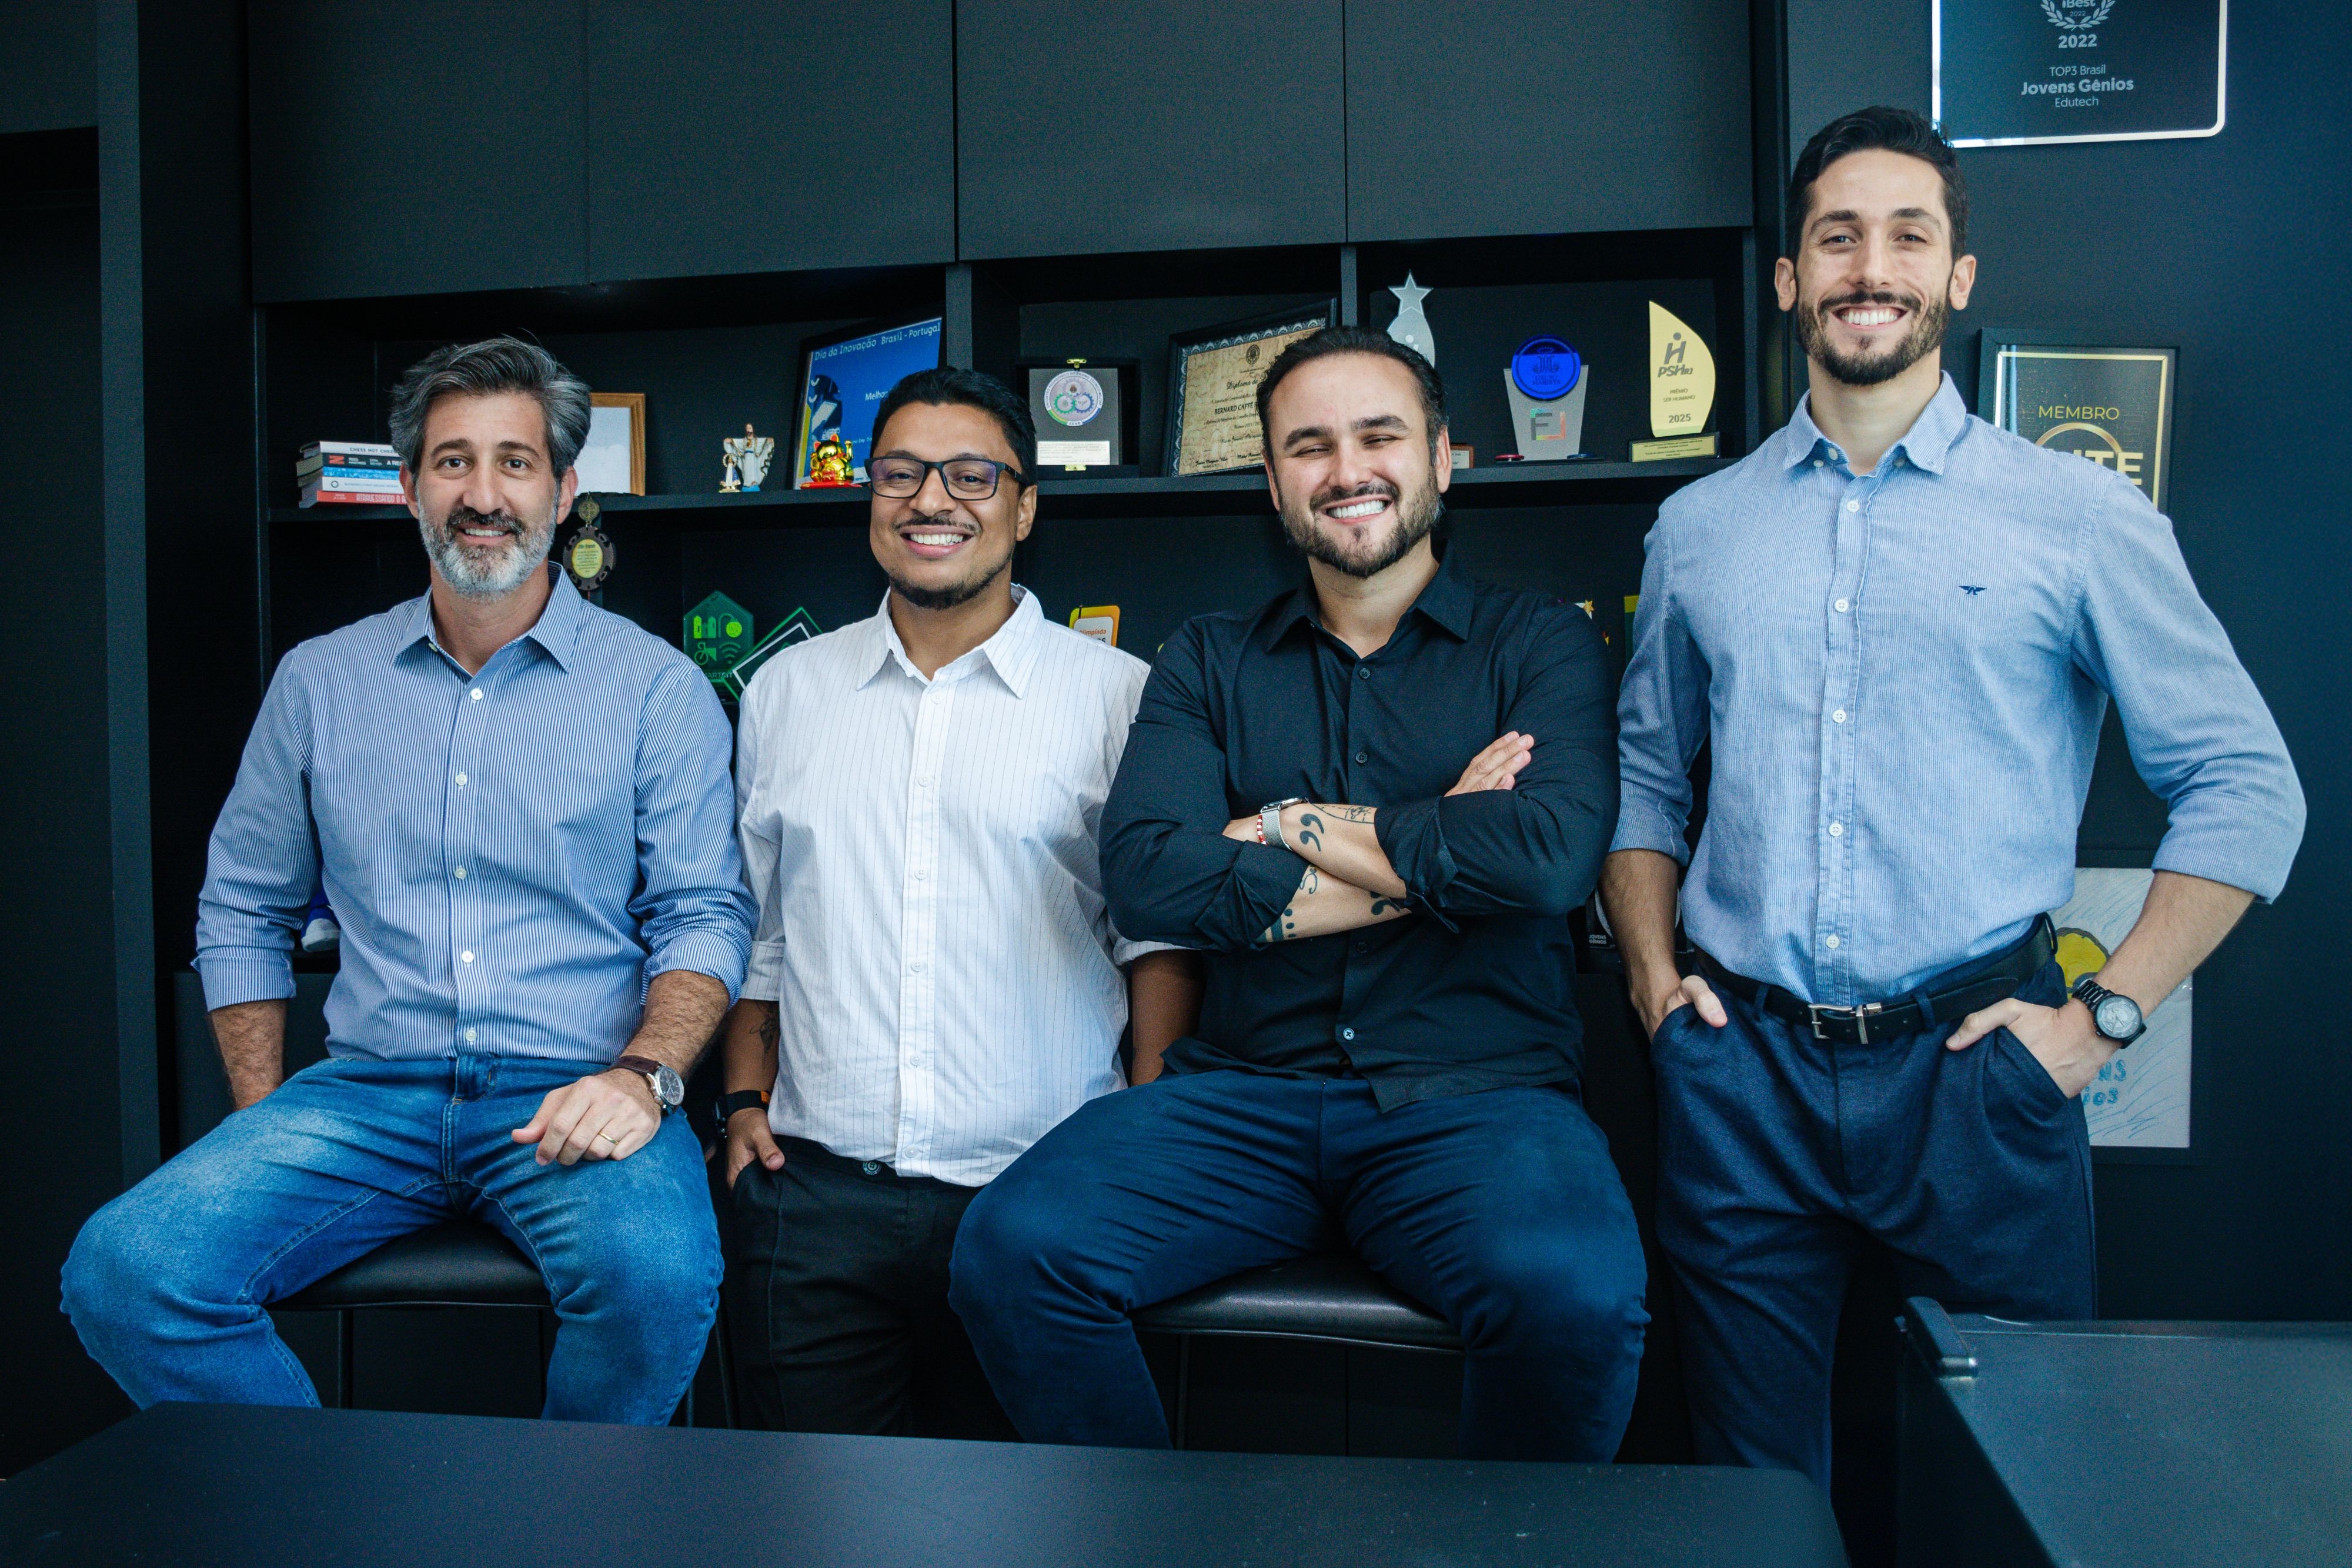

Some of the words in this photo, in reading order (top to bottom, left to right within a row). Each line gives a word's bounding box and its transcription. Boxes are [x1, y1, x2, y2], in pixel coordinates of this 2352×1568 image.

[2058, 34, 2097, 49] 2022
[2049, 66, 2077, 76] TOP3
[2080, 64, 2106, 75] Brasil
[2021, 82, 2075, 95] Jovens
[2078, 77, 2134, 92] Gênios
[2054, 96, 2099, 108] Edutech
[814, 351, 827, 360] Dia
[828, 347, 838, 357] da
[840, 339, 877, 354] Inovação
[881, 332, 903, 345] Brasil
[909, 322, 941, 338] Portugal
[1226, 379, 1251, 390] Diploma
[1214, 405, 1237, 415] BERNARD
[2039, 405, 2120, 420] MEMBRO
[1668, 413, 1692, 423] 2025
